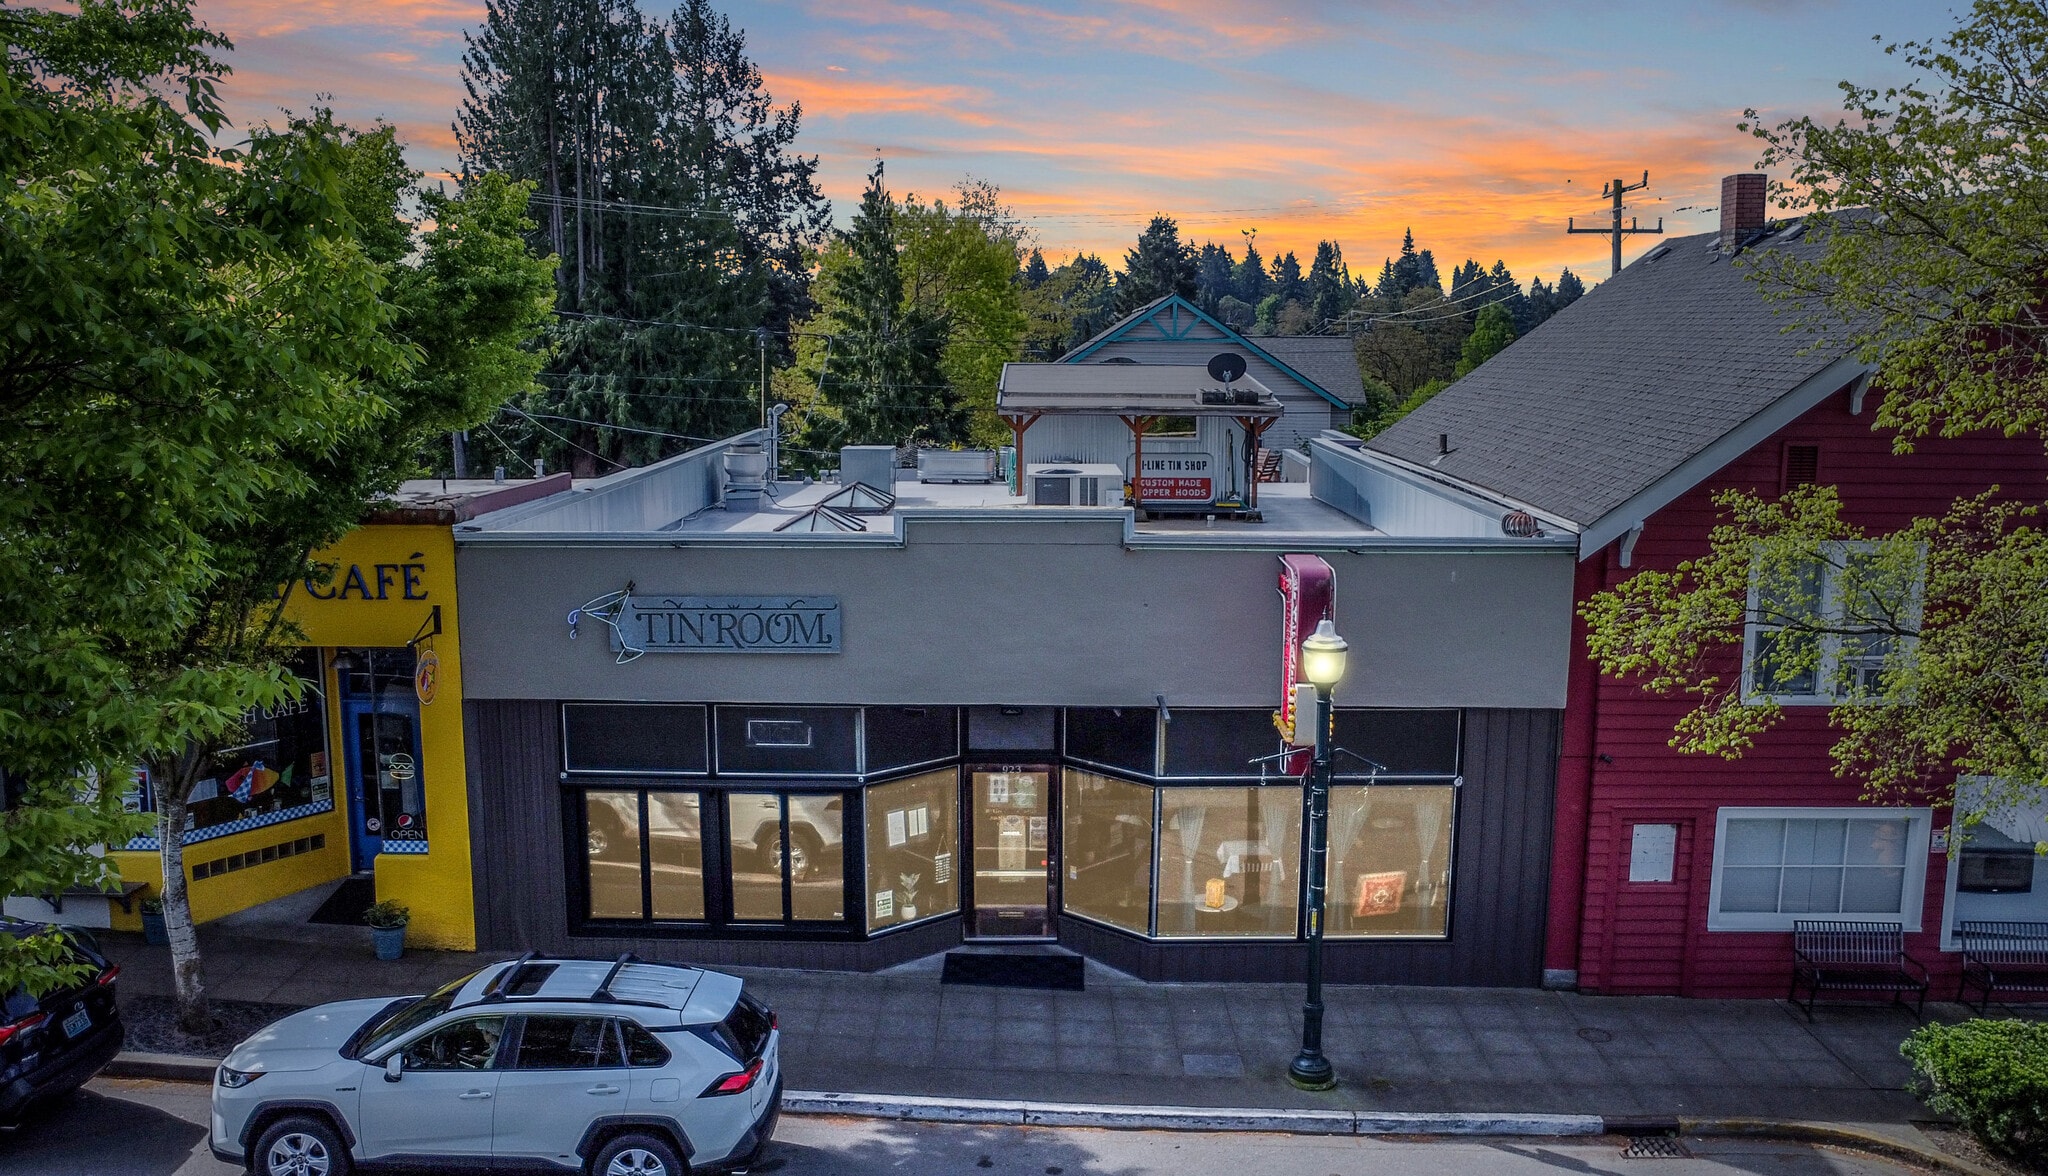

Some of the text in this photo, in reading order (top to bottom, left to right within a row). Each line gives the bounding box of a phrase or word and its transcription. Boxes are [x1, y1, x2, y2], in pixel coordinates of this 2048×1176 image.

[1168, 460, 1182, 471] TIN
[1185, 460, 1207, 471] SHOP
[1140, 479, 1202, 487] CUSTOM MADE
[1141, 488, 1207, 497] OPPER HOODS
[305, 552, 429, 600] CAFÉ
[635, 612, 833, 649] TIN ROOM
[1002, 765, 1022, 774] 923
[390, 829, 424, 840] OPEN
